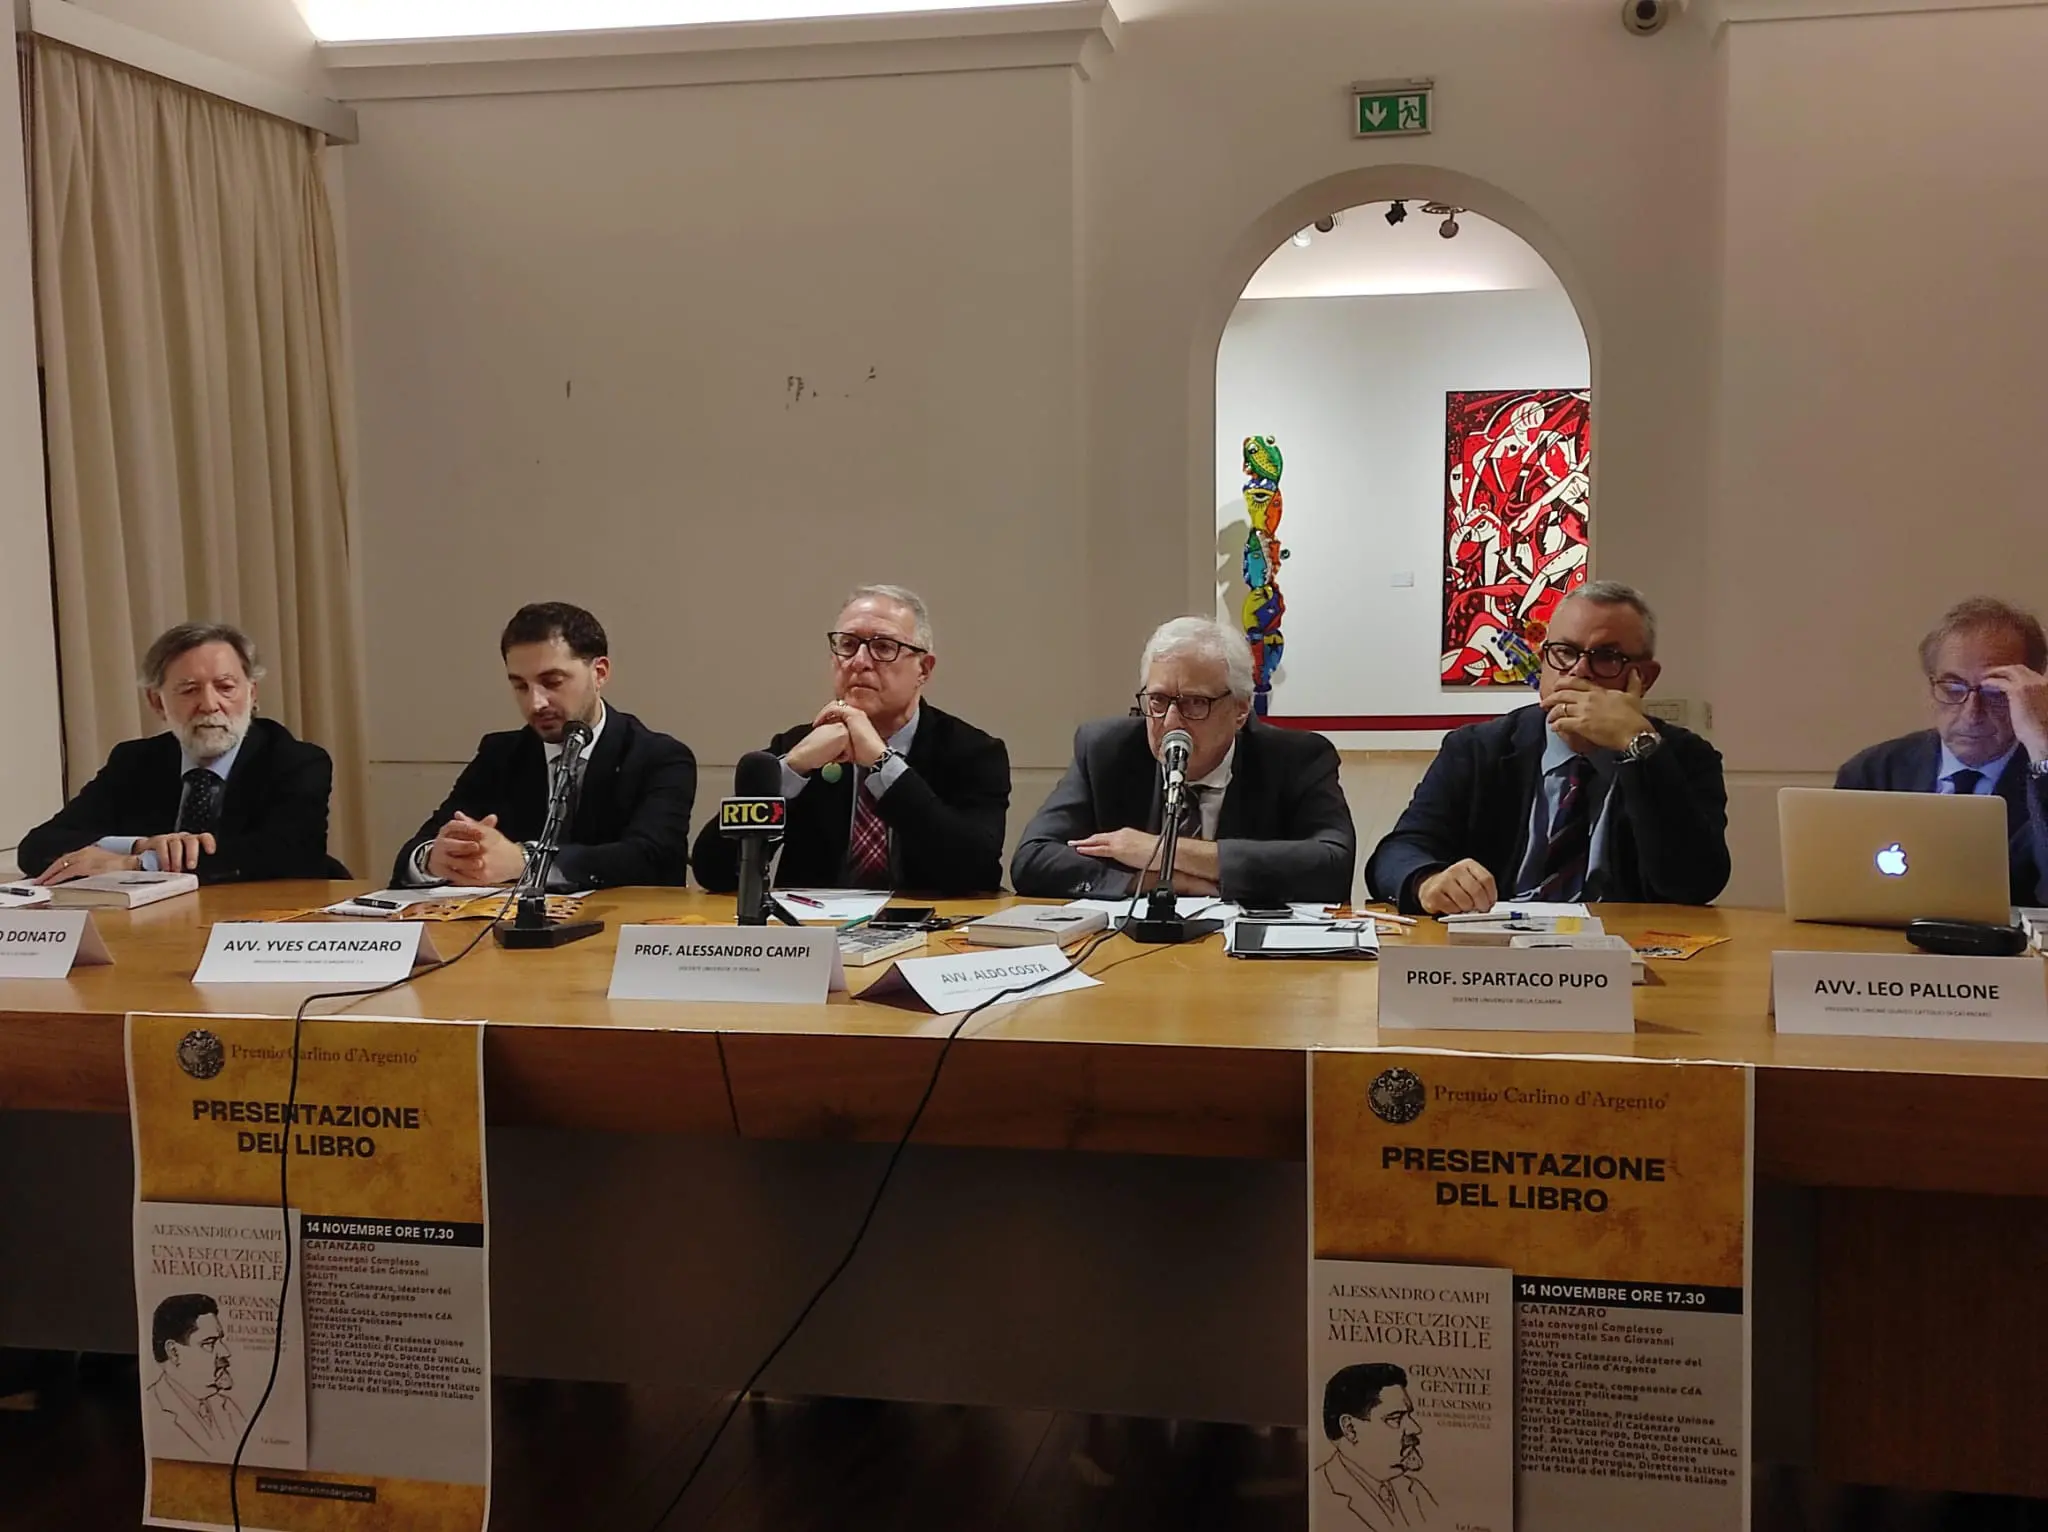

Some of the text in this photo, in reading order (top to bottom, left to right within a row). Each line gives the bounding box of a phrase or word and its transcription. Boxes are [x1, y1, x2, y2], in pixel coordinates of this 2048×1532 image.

[724, 802, 768, 823] RTC
[7, 930, 66, 942] DONATO
[223, 940, 402, 952] AVV. YVES CATANZARO
[634, 944, 810, 958] PROF. ALESSANDRO CAMPI
[940, 963, 1050, 984] AVV. ALDO COSTA
[1406, 970, 1608, 988] PROF. SPARTACO PUPO
[1814, 980, 2000, 1000] AVV. LEO PALLONE
[231, 1044, 283, 1060] Premio
[345, 1048, 418, 1067] d'Argento
[1434, 1084, 1666, 1112] Premio Carlino d'Argento
[192, 1100, 420, 1129] PRESENTAZIONE
[238, 1132, 376, 1158] DEL LIBRO
[1382, 1146, 1666, 1182] PRESENTAZIONE
[1436, 1182, 1609, 1213] DEL LIBRO
[152, 1224, 282, 1241] ALESSANDRO CAMPI
[306, 1222, 454, 1239] 14 NOVEMBRE ORE 17.30
[152, 1244, 283, 1264] UNA ESECUZIONE
[306, 1240, 375, 1252] CATANZARO
[152, 1260, 284, 1282] MEMORABILE
[218, 1295, 282, 1309] GIOVANN
[1328, 1284, 1490, 1304] ALESSANDRO CAMPI
[1520, 1283, 1705, 1305] 14 NOVEMBRE ORE 17.30
[228, 1308, 279, 1322] GENTIL
[1328, 1308, 1492, 1330] UNA ESECUZIONE
[1520, 1303, 1606, 1318] CATANZARO
[1520, 1318, 1662, 1335] Sala convegni Complesso
[1328, 1324, 1492, 1350] MEMORABILE
[1520, 1338, 1559, 1349] SALUTI
[1408, 1364, 1491, 1380] GIOVANNI
[1420, 1380, 1491, 1396] GENTILE
[1430, 1399, 1491, 1410] FASCISMO
